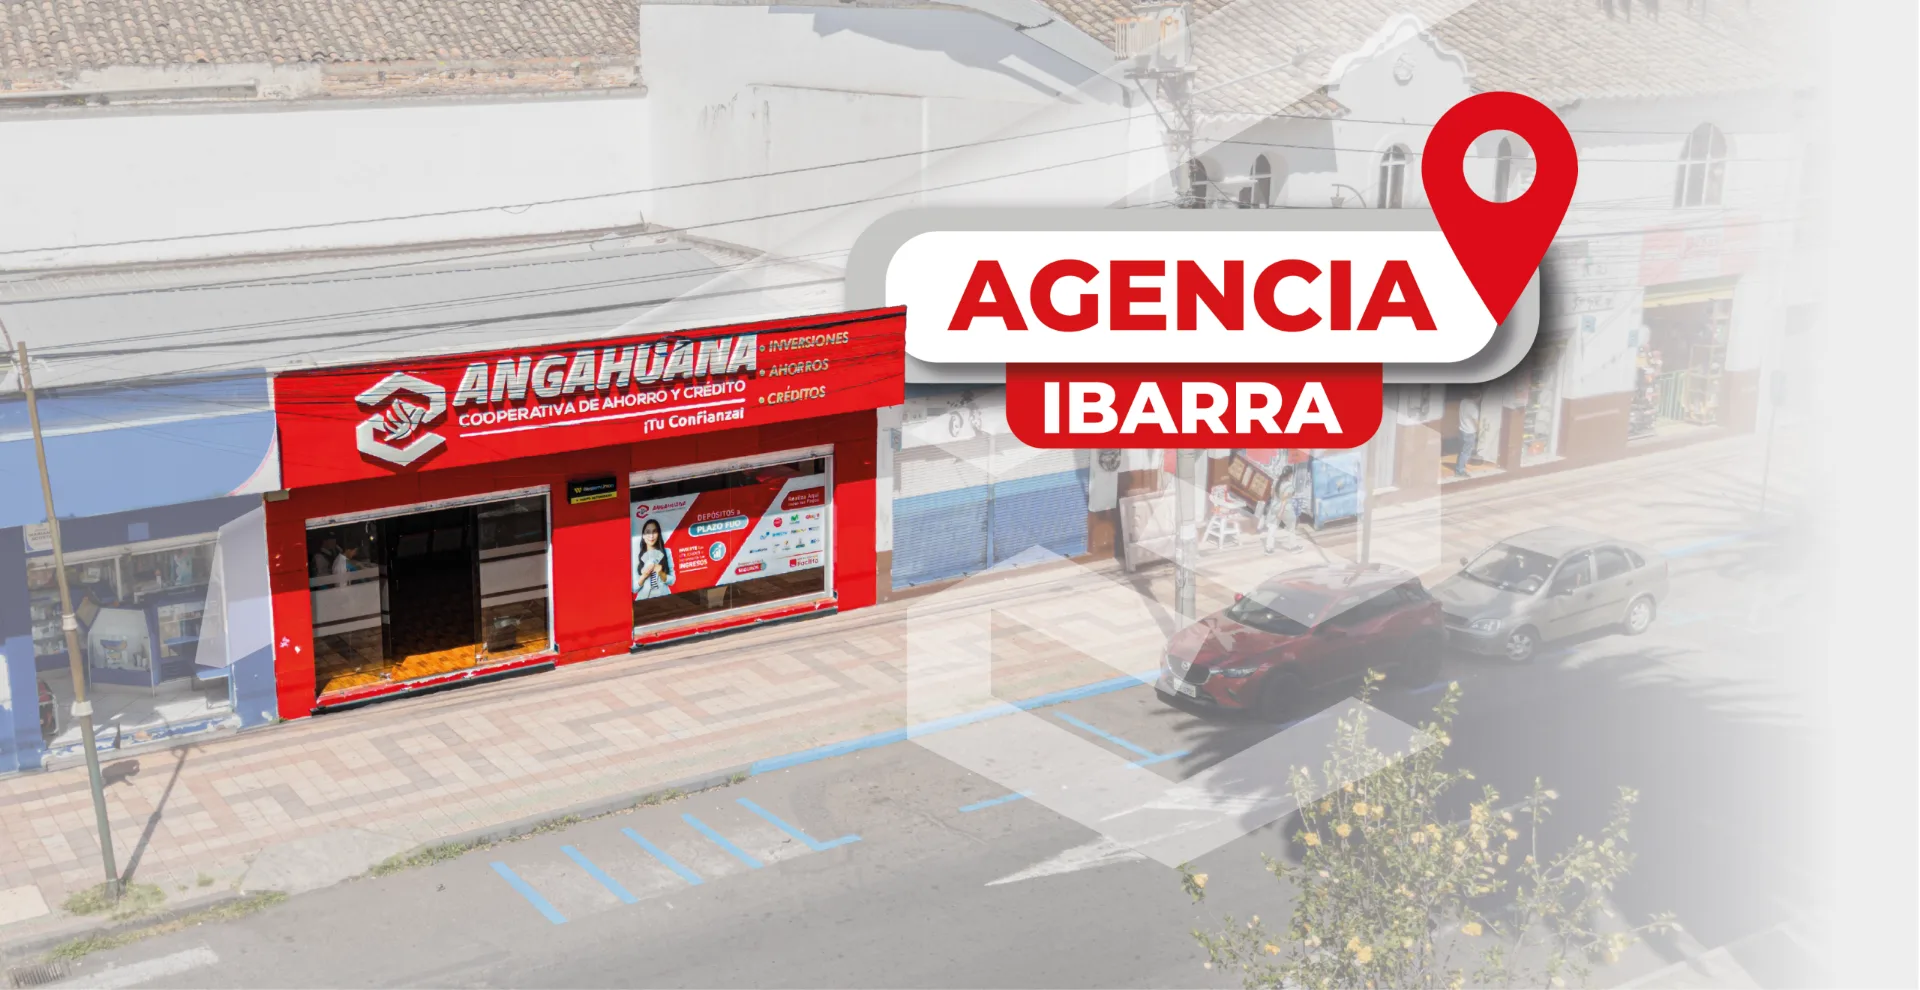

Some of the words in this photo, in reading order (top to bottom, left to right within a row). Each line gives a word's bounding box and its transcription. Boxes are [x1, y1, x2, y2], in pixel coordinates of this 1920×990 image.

[768, 331, 850, 353] INVERSIONES
[452, 334, 757, 406] ANGAHUANA
[768, 358, 830, 378] AHORROS
[459, 404, 576, 427] COOPERATIVA
[579, 400, 598, 414] DE
[602, 391, 667, 408] AHORRO
[671, 387, 681, 401] Y
[683, 379, 746, 398] CRÉDITO
[766, 385, 827, 405] CRÉDITOS
[697, 509, 735, 521] DEPÓSITOS
[697, 521, 723, 534] PLAZO
[679, 559, 708, 569] INGRESOS
